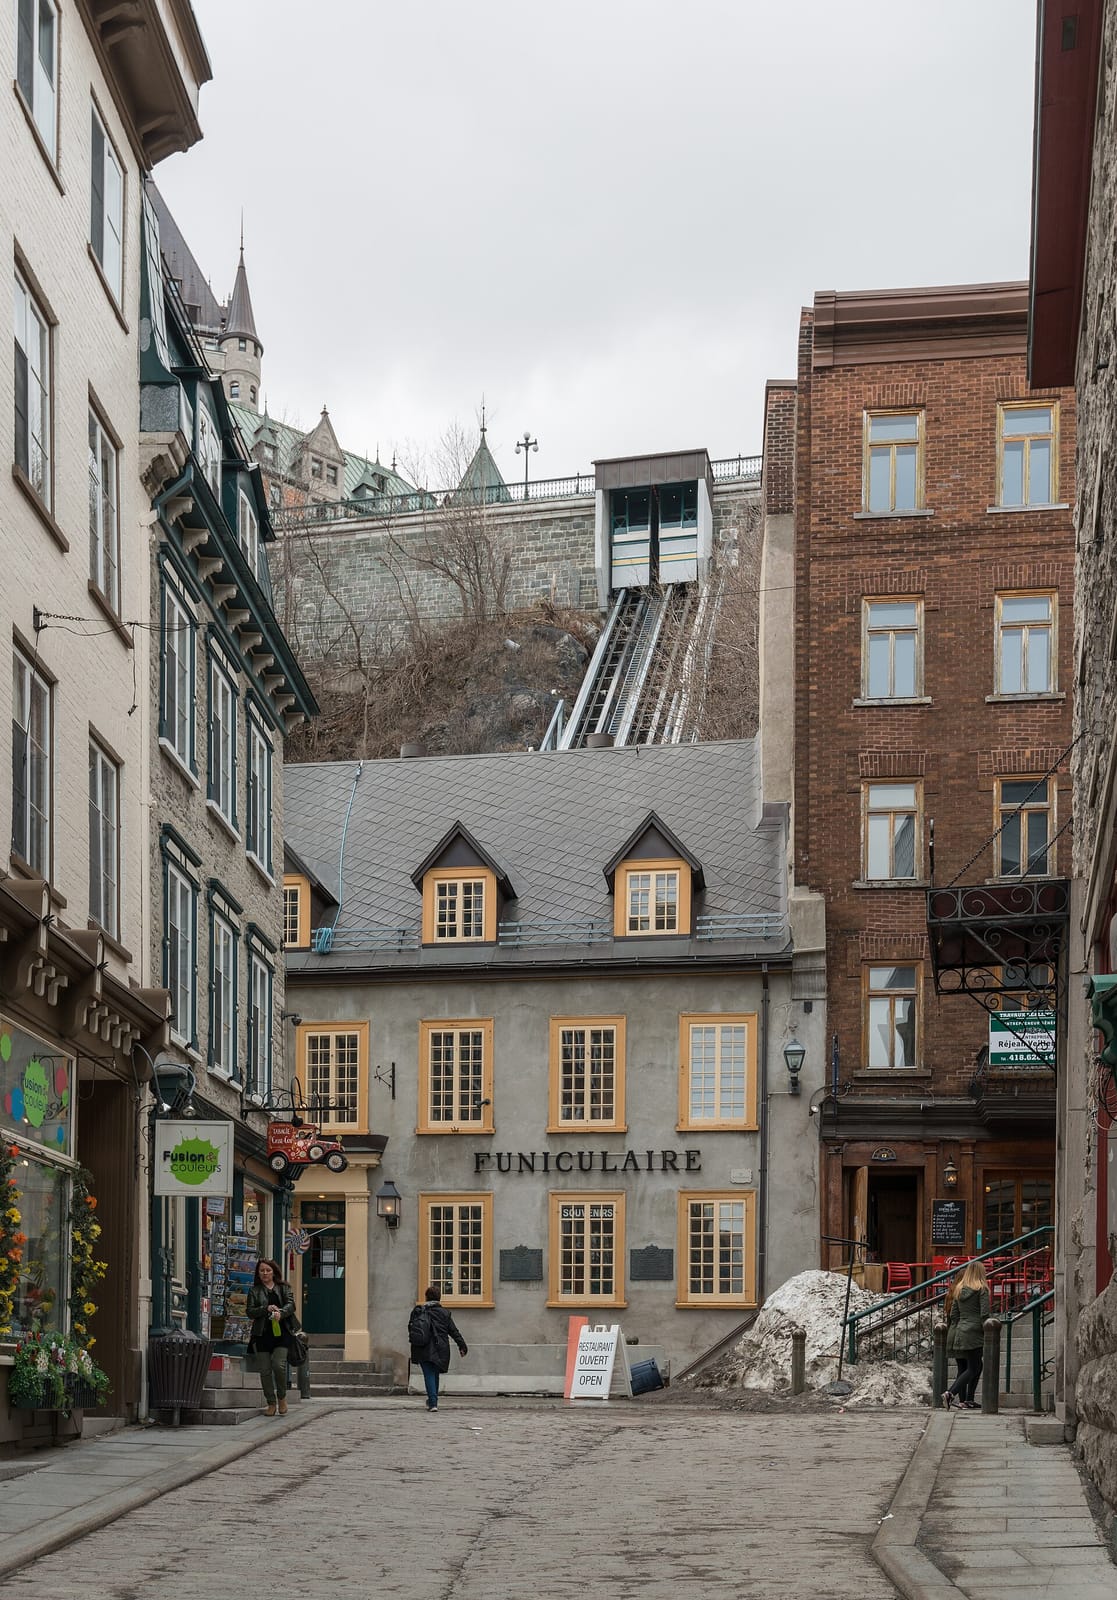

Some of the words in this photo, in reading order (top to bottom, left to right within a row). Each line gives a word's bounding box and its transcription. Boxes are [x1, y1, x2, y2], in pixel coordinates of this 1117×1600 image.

[163, 1150, 205, 1163] Fusion
[206, 1151, 217, 1163] &
[474, 1150, 702, 1173] FUNICULAIRE
[170, 1163, 222, 1173] couleurs
[249, 1215, 258, 1223] 59
[578, 1342, 614, 1352] RESTAURANT
[579, 1355, 609, 1366] OUVERT
[579, 1375, 603, 1386] OPEN
